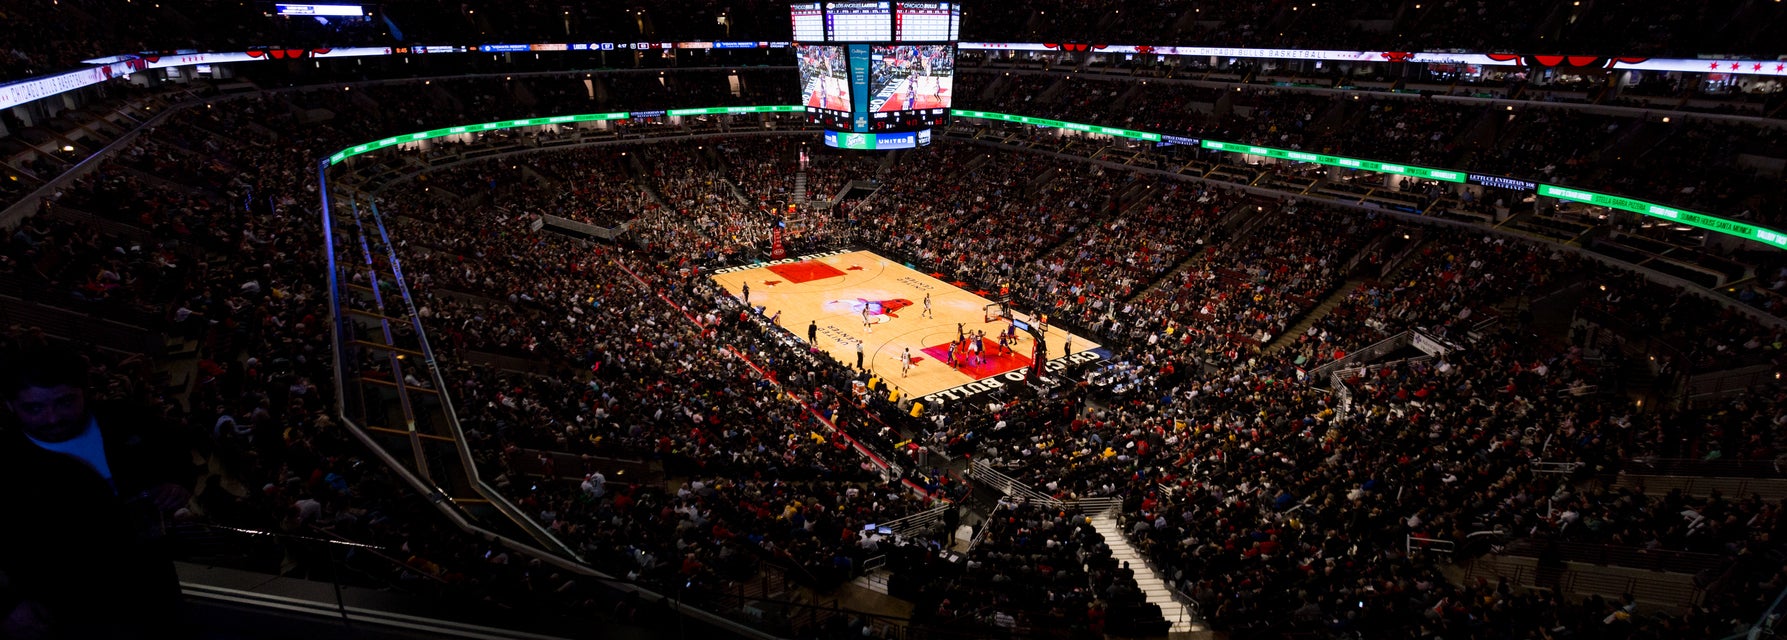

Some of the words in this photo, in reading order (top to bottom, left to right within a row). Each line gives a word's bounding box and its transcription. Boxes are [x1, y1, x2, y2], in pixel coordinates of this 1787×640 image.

[11, 82, 39, 102] CHICAGO
[847, 135, 865, 146] Sprite
[1470, 174, 1494, 183] LETTUCE
[1495, 177, 1524, 186] ENTERTAIN
[1481, 181, 1525, 191] RESTAURANTS
[1595, 196, 1611, 204] STELLA
[1612, 198, 1627, 206] BARRA
[1628, 201, 1646, 210] PIZZERIA
[1680, 213, 1701, 224] SUMMER
[1701, 216, 1716, 227] HOUSE
[1716, 219, 1732, 230] SANTA
[1732, 223, 1752, 235] MONICA
[714, 258, 794, 274] CHICAGO
[798, 249, 852, 261] BULLS
[896, 278, 926, 291] UNITED
[904, 276, 934, 289] CENTER
[817, 328, 848, 345] UNITED
[827, 325, 858, 342] CENTER
[924, 377, 1003, 405] BULLS
